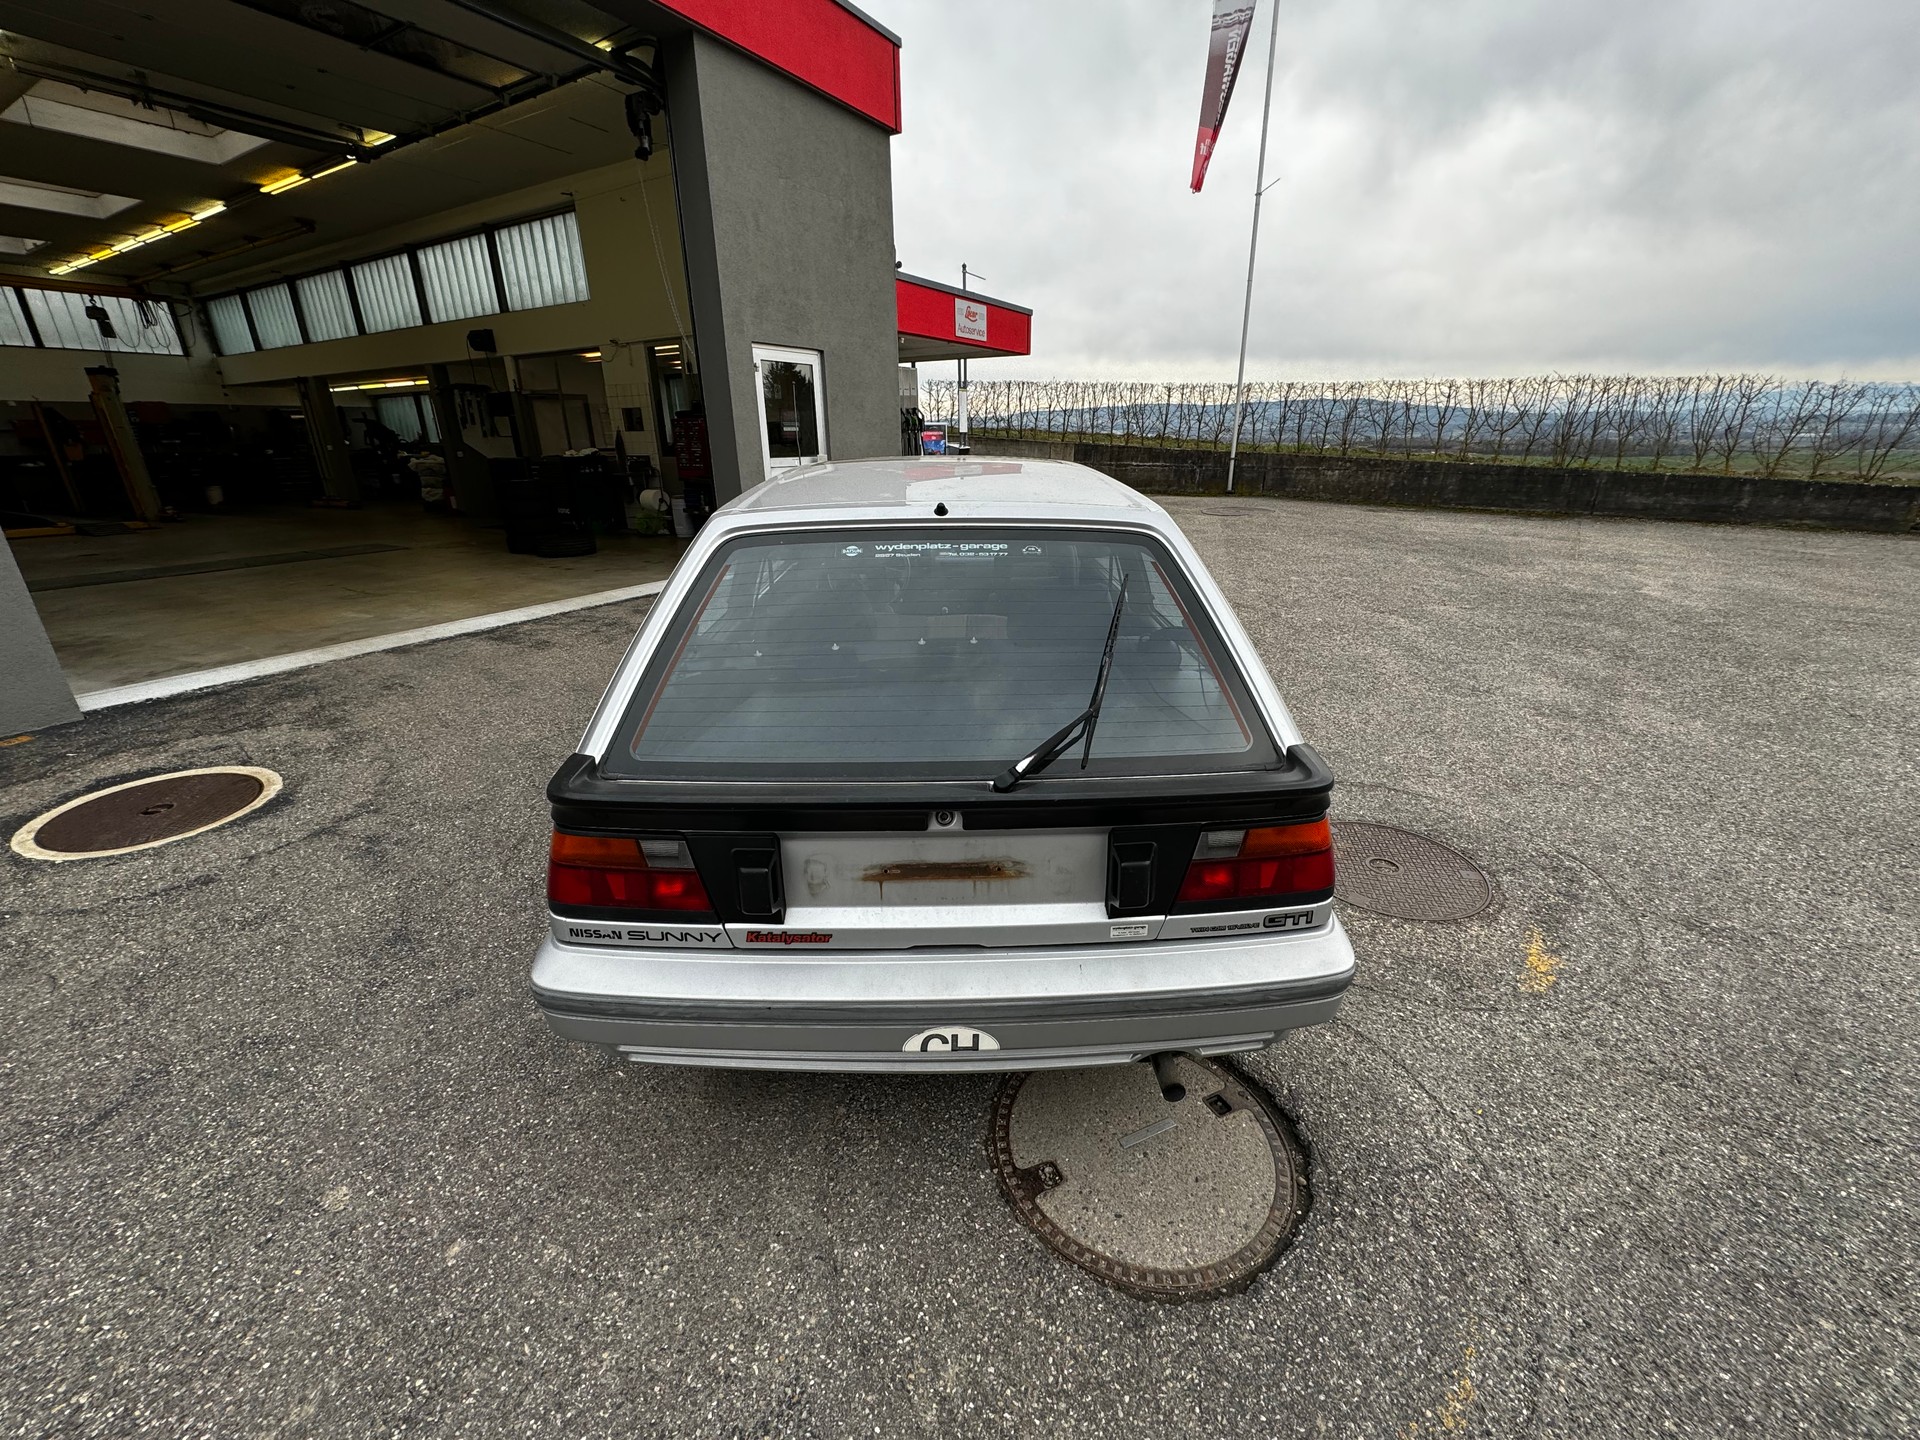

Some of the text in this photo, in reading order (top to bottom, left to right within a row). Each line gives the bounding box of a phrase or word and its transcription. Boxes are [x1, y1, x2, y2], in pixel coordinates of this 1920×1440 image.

[958, 323, 986, 337] Autoservice
[569, 928, 722, 942] NISSAN SUNNY
[746, 931, 833, 945] Katalysator
